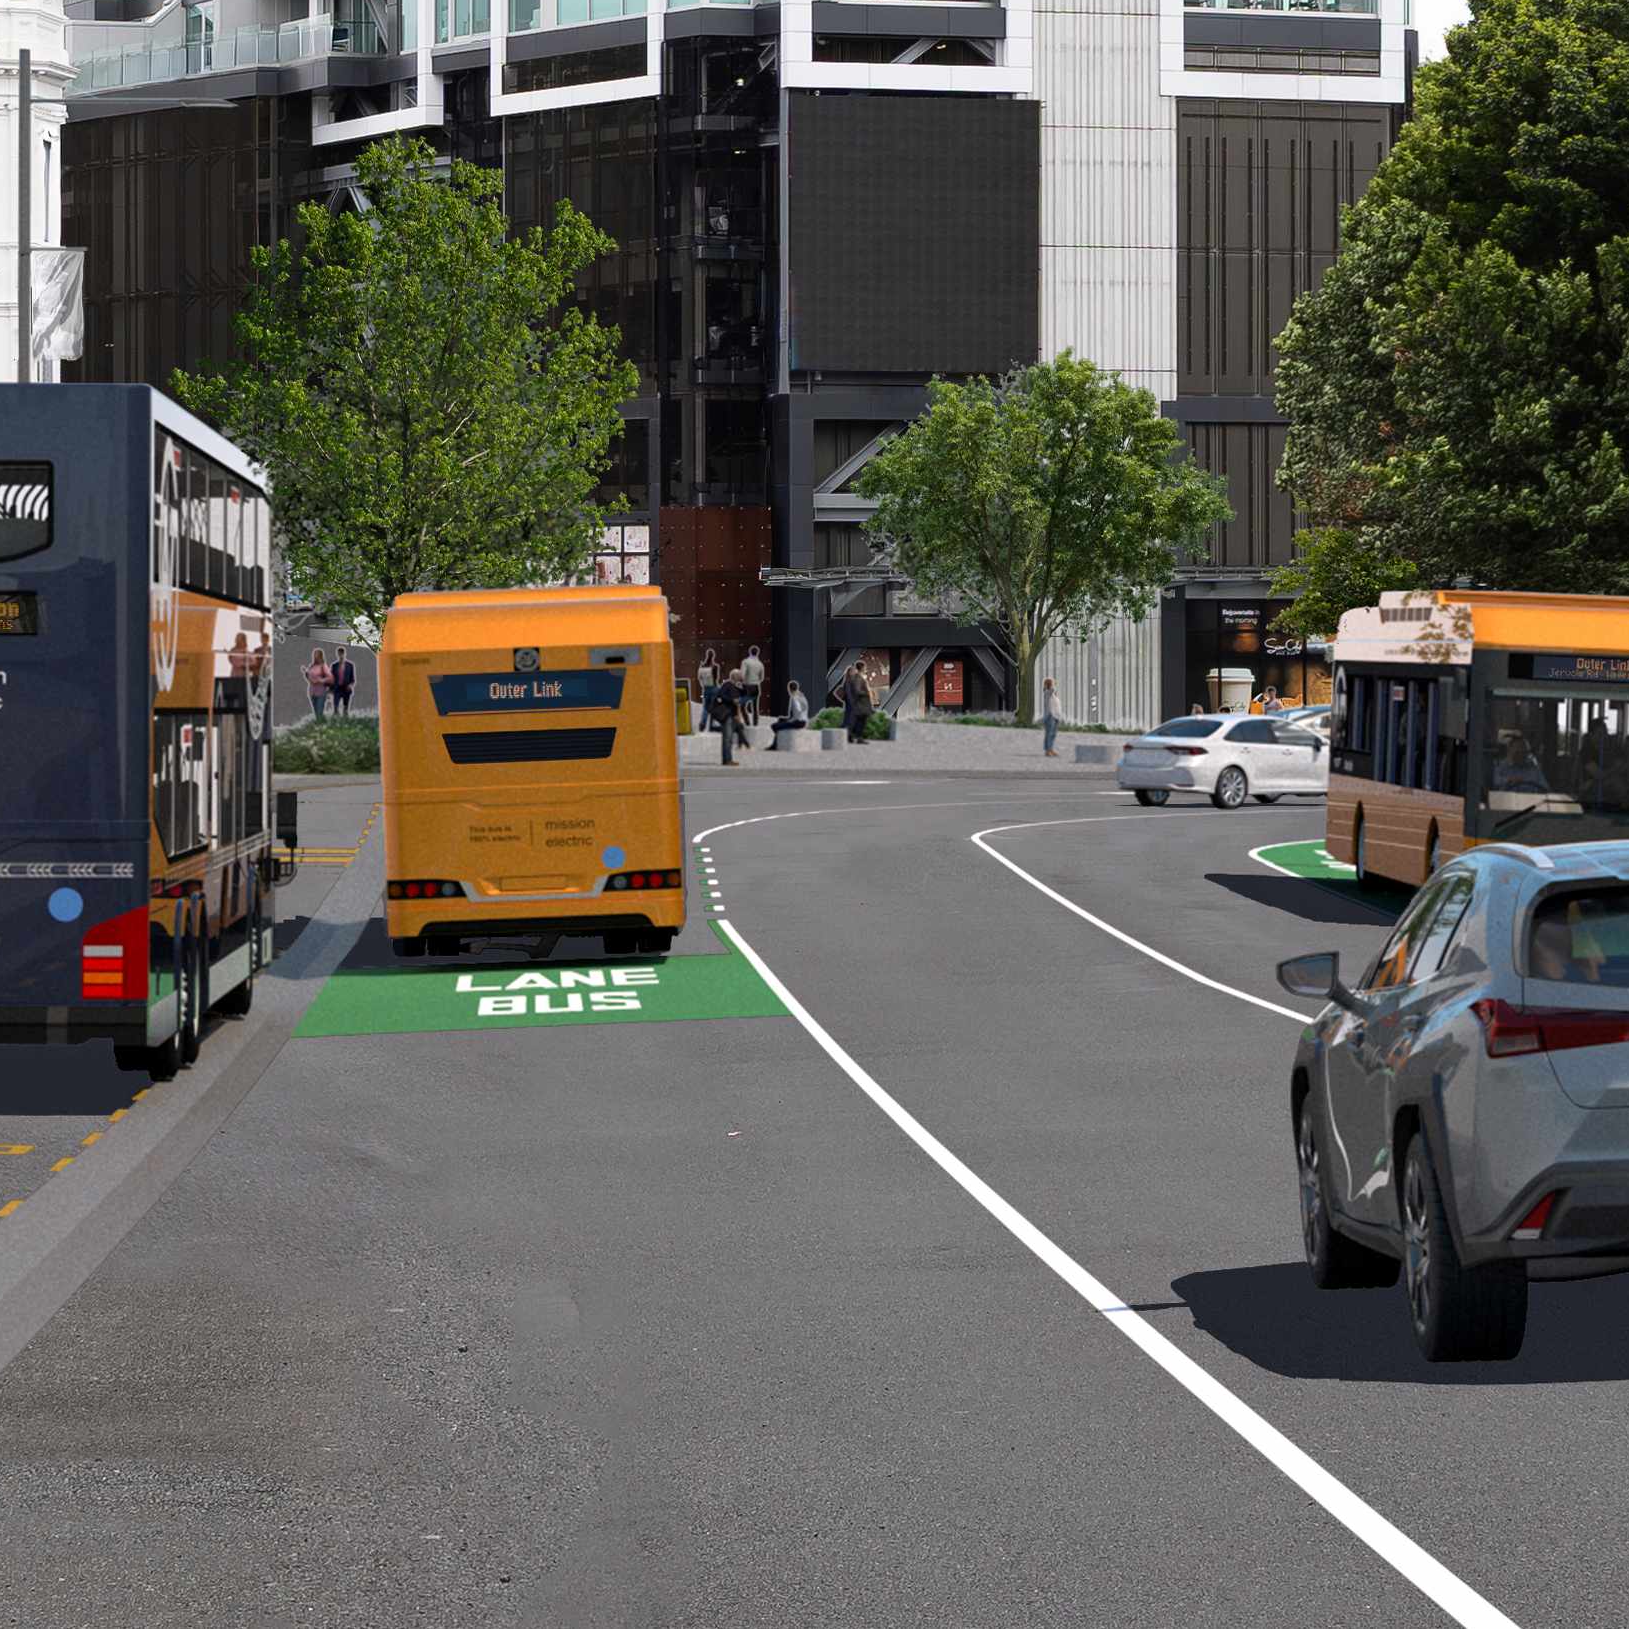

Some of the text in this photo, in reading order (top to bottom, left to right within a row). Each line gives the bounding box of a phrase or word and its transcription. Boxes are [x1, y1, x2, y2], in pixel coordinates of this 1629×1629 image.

[489, 680, 563, 699] Outer Link
[545, 819, 596, 831] mission
[545, 836, 594, 847] electric
[455, 967, 660, 992] LANE
[477, 991, 642, 1016] BUS
